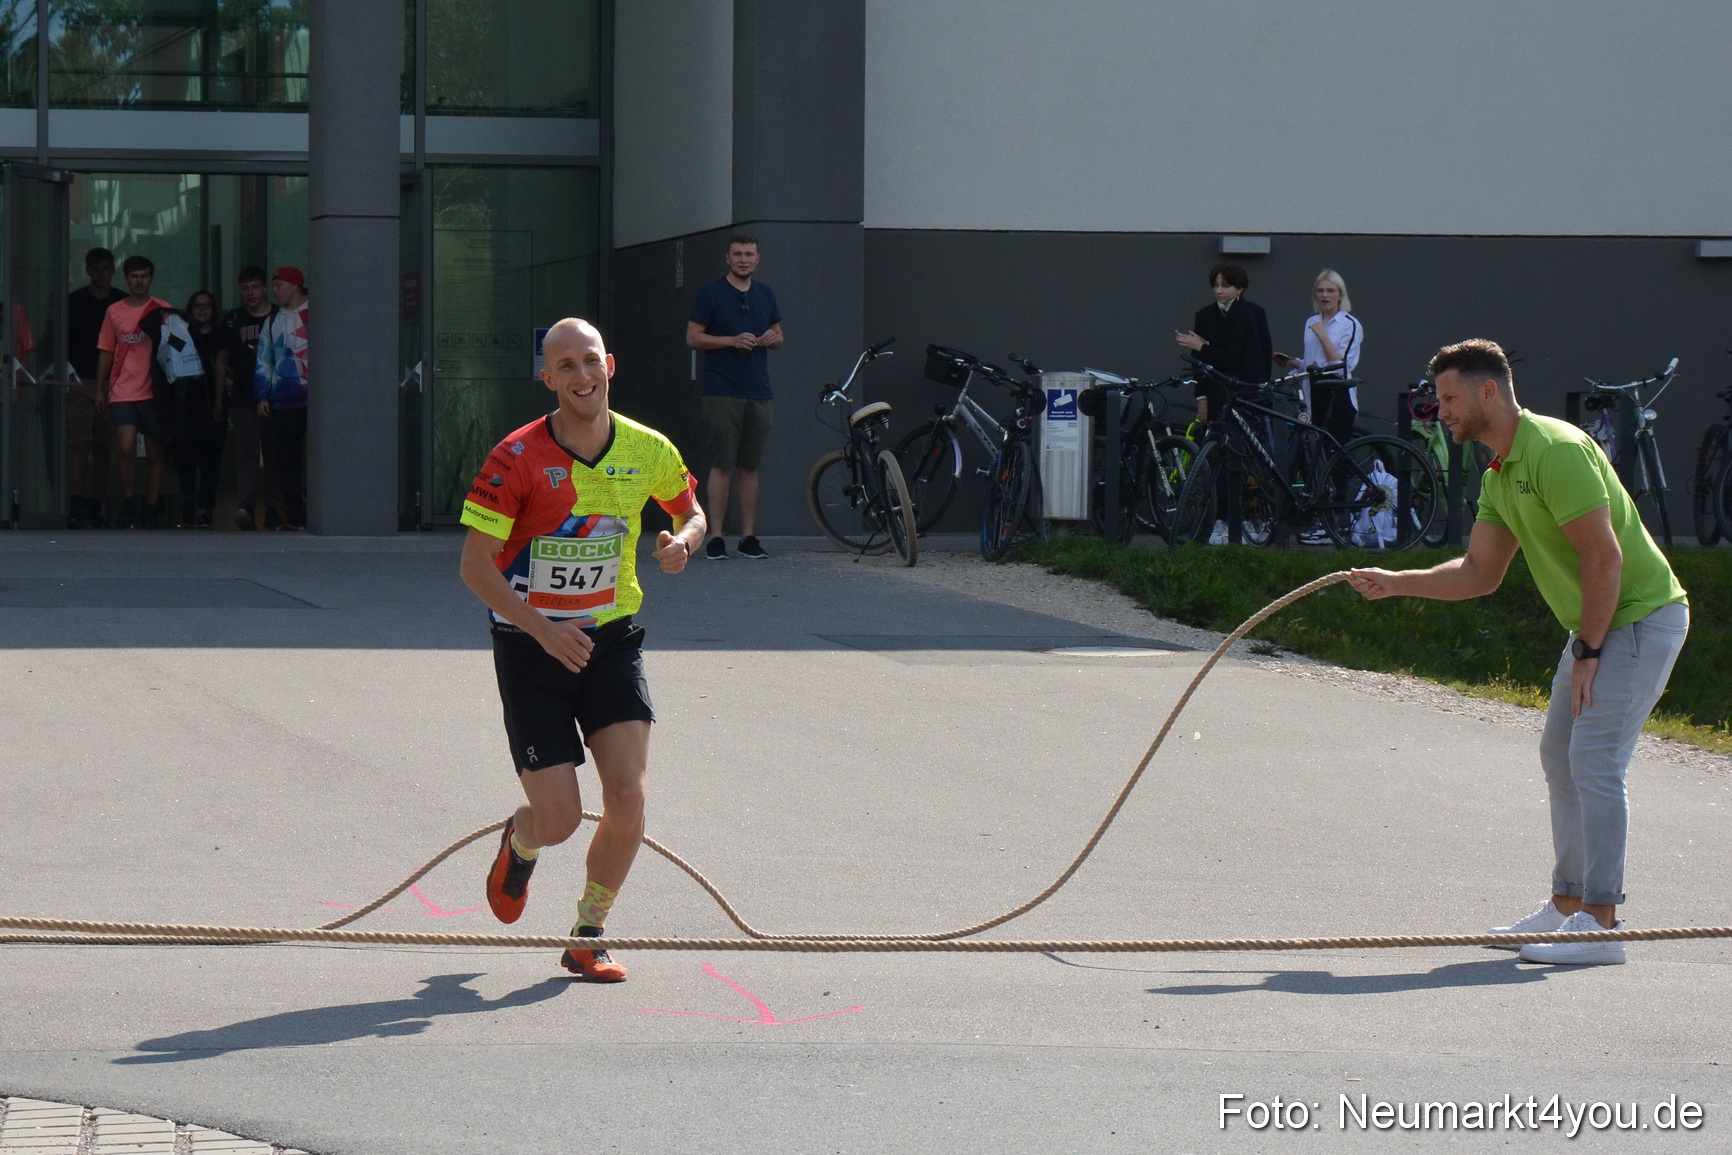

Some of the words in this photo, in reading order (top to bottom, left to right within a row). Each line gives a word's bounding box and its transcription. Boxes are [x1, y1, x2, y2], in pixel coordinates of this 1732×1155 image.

[464, 505, 499, 524] Motorsport
[539, 540, 616, 559] BOCK
[549, 566, 604, 589] 547
